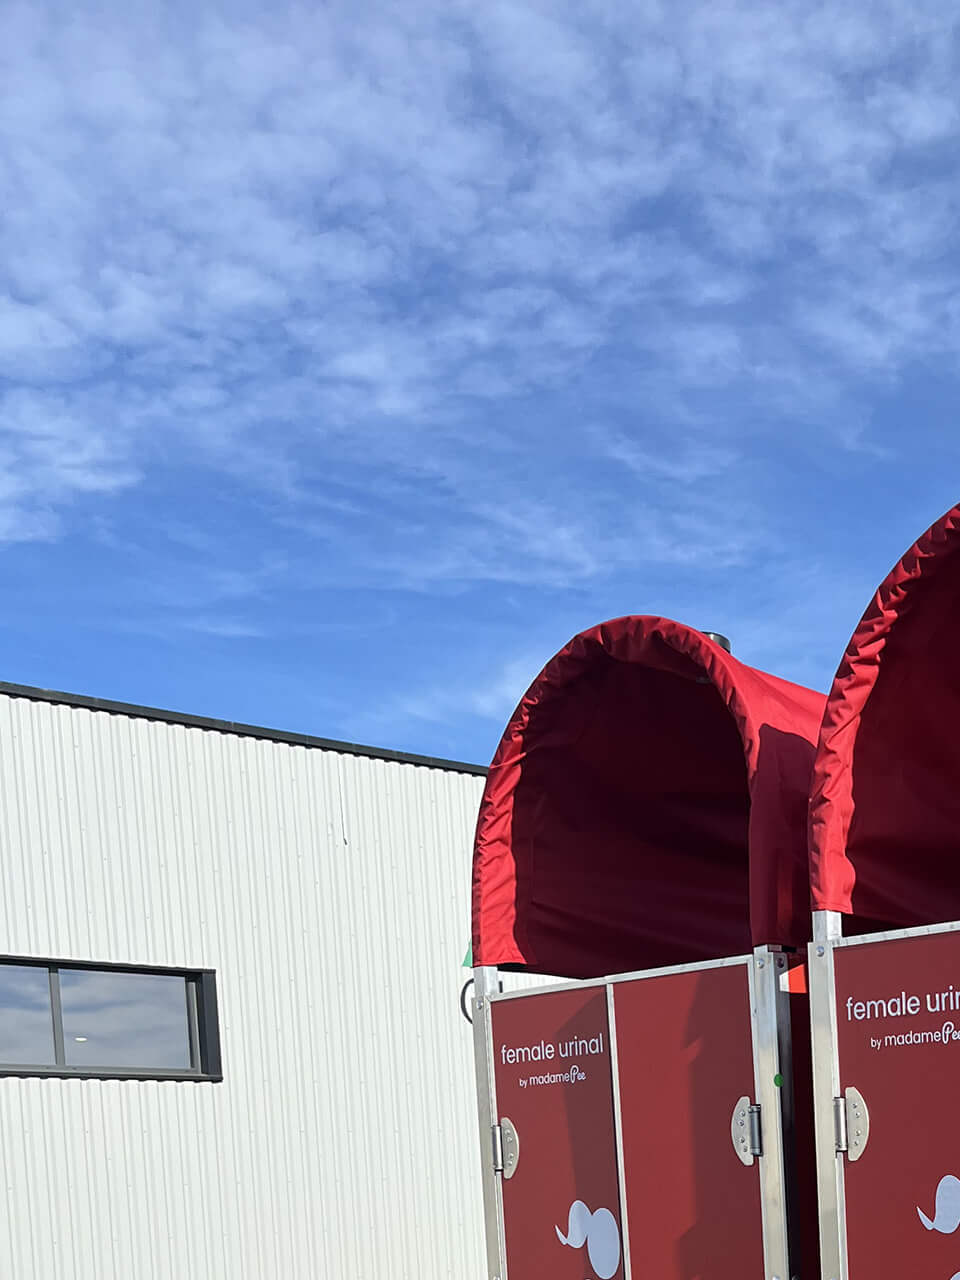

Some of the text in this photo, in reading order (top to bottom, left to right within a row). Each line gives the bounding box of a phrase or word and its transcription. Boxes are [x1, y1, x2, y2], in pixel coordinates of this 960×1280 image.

[846, 991, 921, 1021] female
[501, 1032, 604, 1065] female urinal
[870, 1037, 882, 1050] by
[519, 1078, 529, 1089] by
